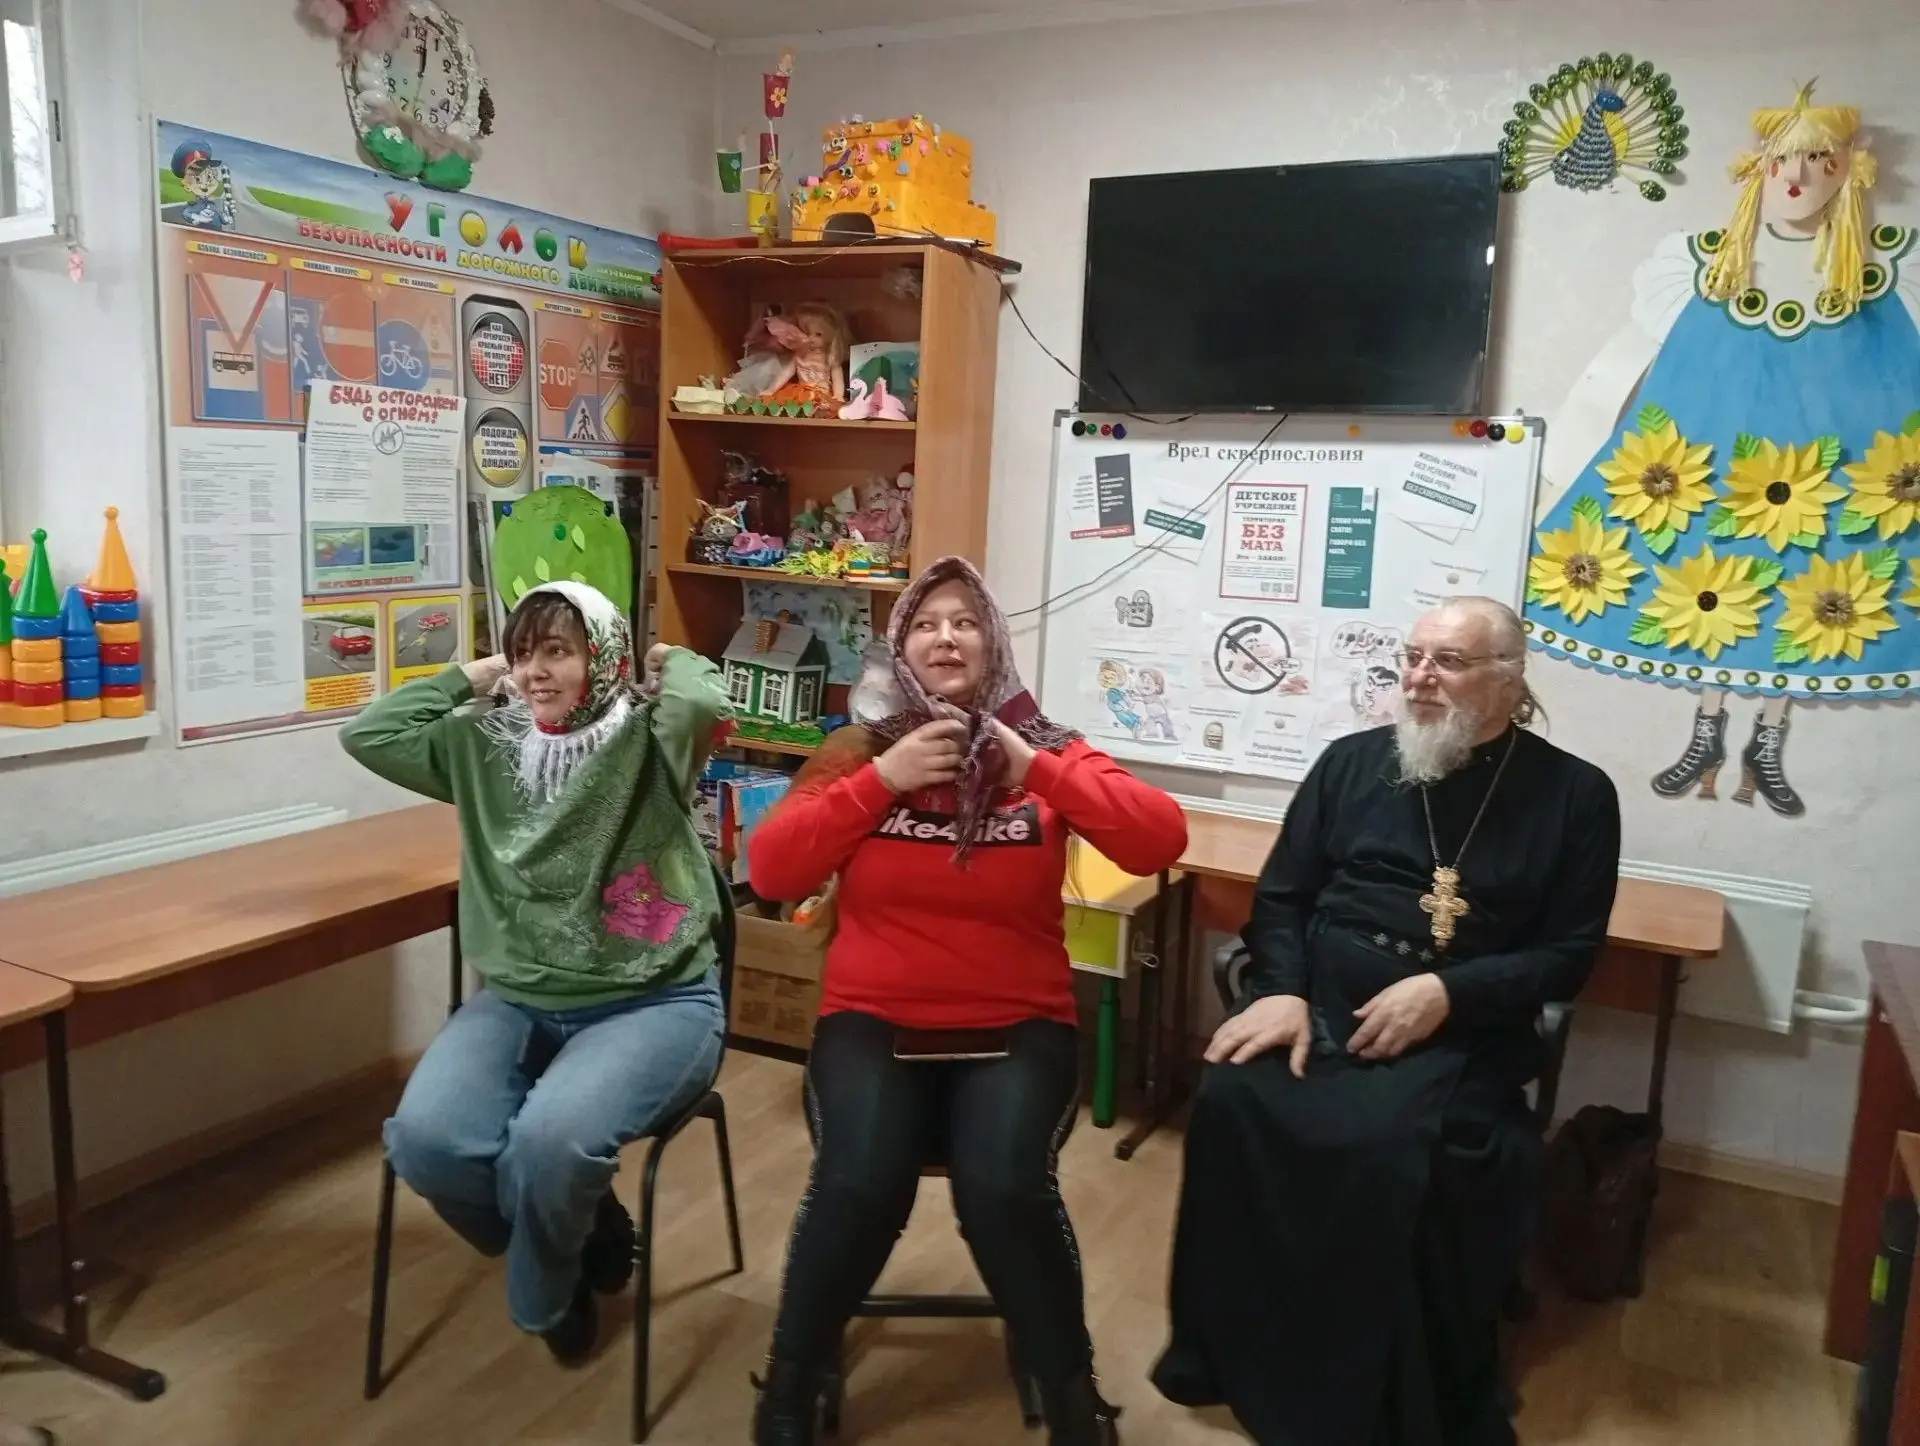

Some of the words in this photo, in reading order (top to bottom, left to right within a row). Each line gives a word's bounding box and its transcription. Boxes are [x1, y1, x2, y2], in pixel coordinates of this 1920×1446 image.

[298, 219, 448, 263] БЕЗОПАСНОСТИ
[457, 249, 561, 285] ДОРОЖНОГО
[488, 372, 509, 386] НЕТ!
[539, 364, 576, 386] STOP
[329, 384, 373, 406] БУДЬ
[481, 459, 520, 469] ДОЖДИСЬ!
[1217, 447, 1363, 465] сквернословия
[1235, 491, 1297, 502] ДЕТСКОЕ
[1235, 502, 1297, 511] УЧРЕЖДЕНИЕ
[1242, 524, 1285, 540] БЕЗ
[1240, 540, 1283, 551] МАТА
